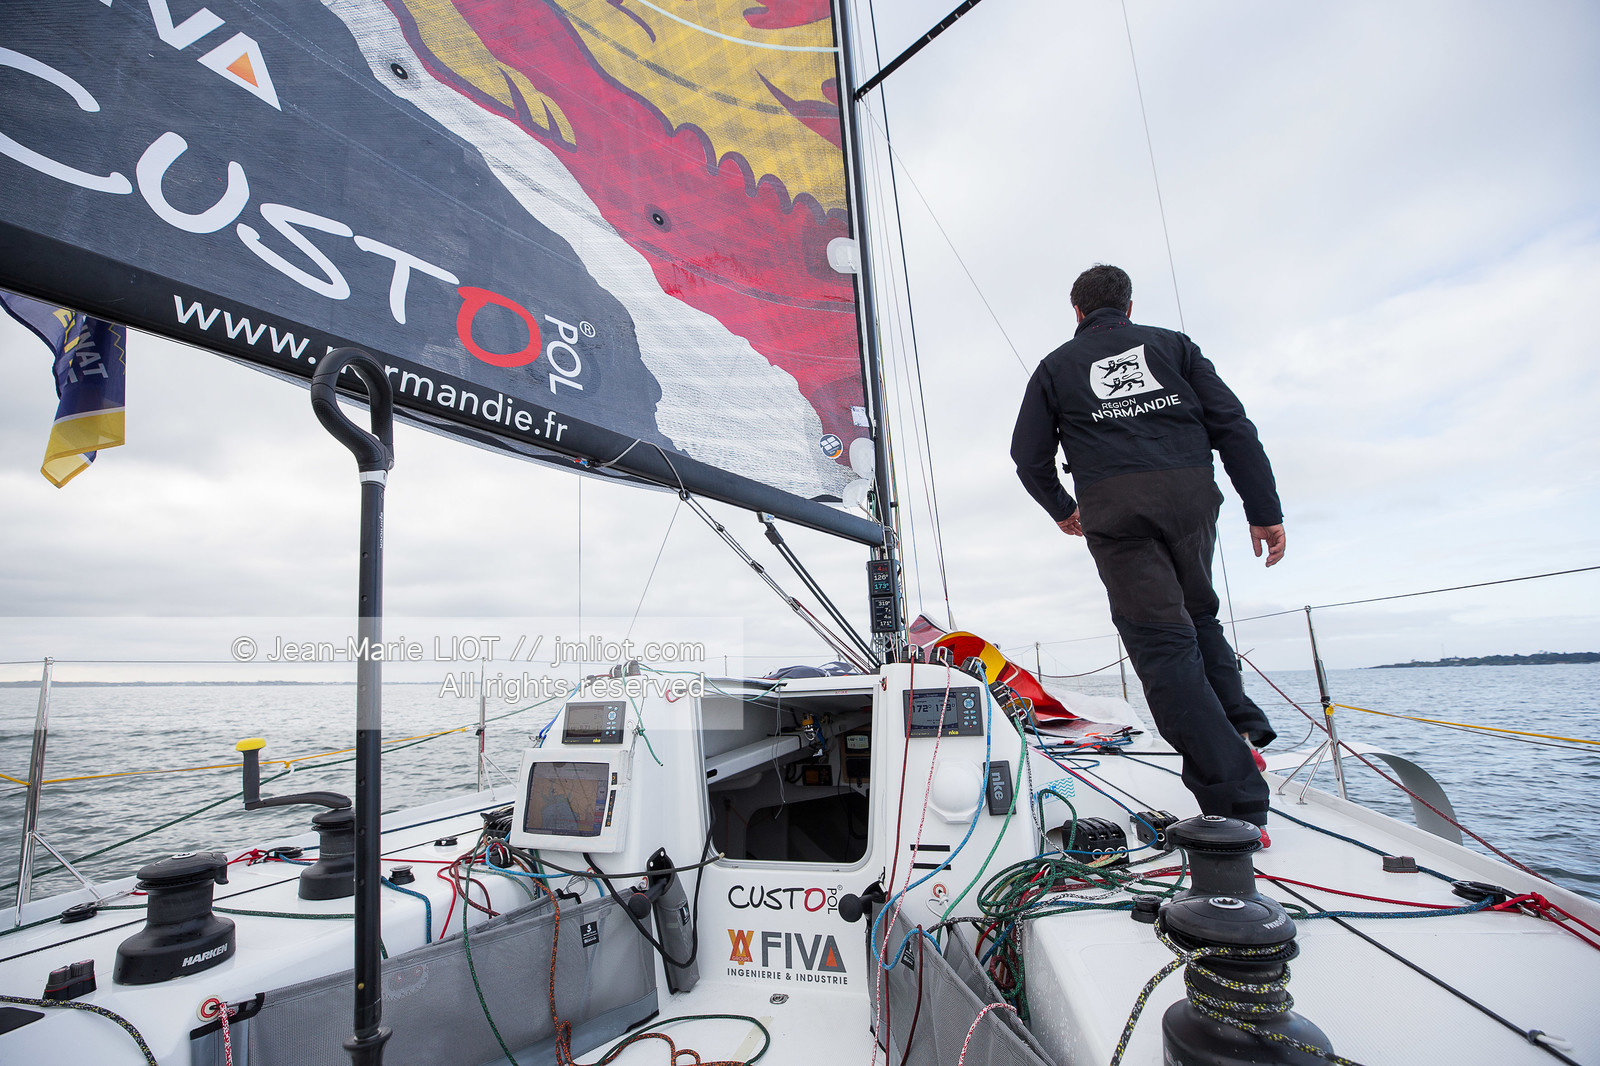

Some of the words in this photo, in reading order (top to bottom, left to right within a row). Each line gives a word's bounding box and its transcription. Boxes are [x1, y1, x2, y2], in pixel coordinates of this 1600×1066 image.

[544, 314, 584, 395] POL
[173, 294, 569, 443] www.rmandie.fr
[1091, 394, 1182, 423] NORMANDIE
[1101, 397, 1137, 410] RÉGION
[991, 772, 1004, 800] nke
[728, 885, 826, 912] CUSTO
[827, 887, 838, 914] POL
[182, 943, 228, 967] HARKEN
[761, 931, 847, 973] FIVA
[727, 968, 781, 980] INGENIERIE
[785, 972, 792, 981] &
[796, 973, 848, 985] INDUSTRIE
